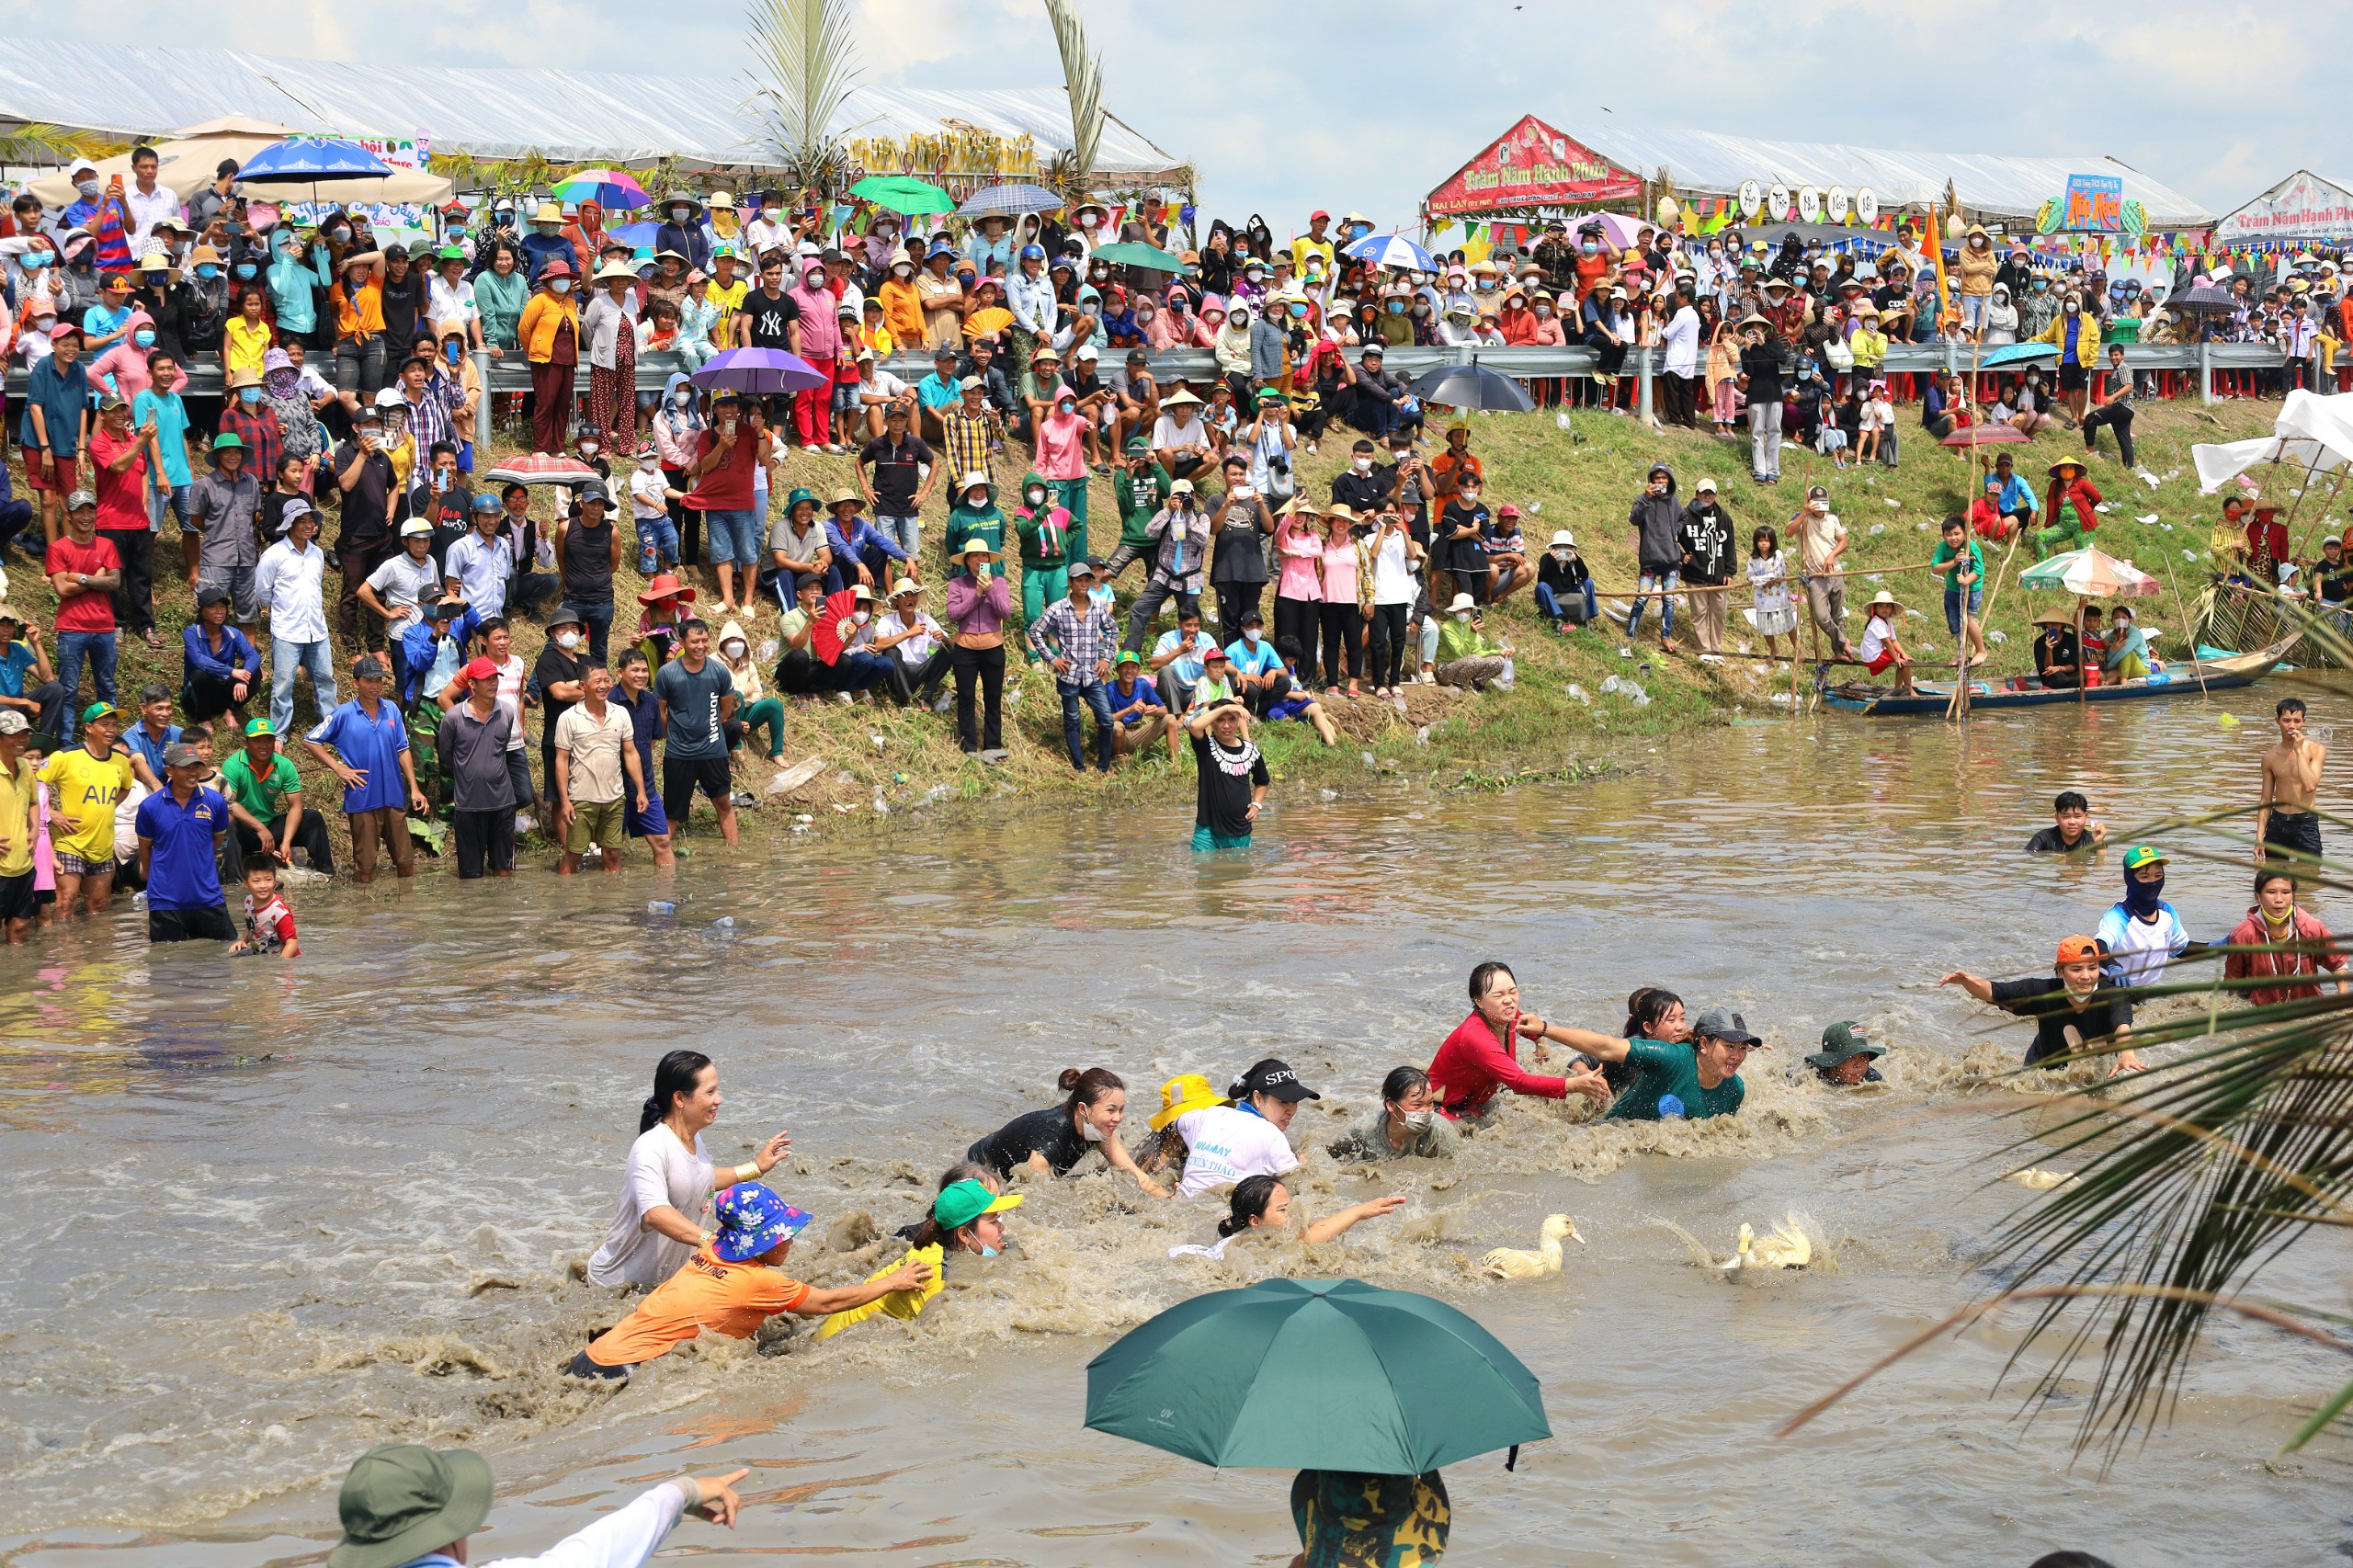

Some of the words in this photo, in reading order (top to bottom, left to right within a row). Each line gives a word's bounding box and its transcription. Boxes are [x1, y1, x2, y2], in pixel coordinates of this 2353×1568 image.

[1465, 167, 1499, 189] Trăm
[1501, 165, 1531, 187] Năm
[1533, 162, 1570, 187] Hạnh
[1572, 159, 1608, 185] Phúc
[1432, 201, 1448, 210] HAI
[1449, 199, 1468, 209] LAN
[374, 217, 391, 226] GIÁO
[2238, 212, 2269, 228] Trăm
[2272, 210, 2299, 226] Năm
[2301, 207, 2333, 226] Hạnh
[1888, 300, 1907, 308] CDG
[1160, 1407, 1175, 1419] UV
